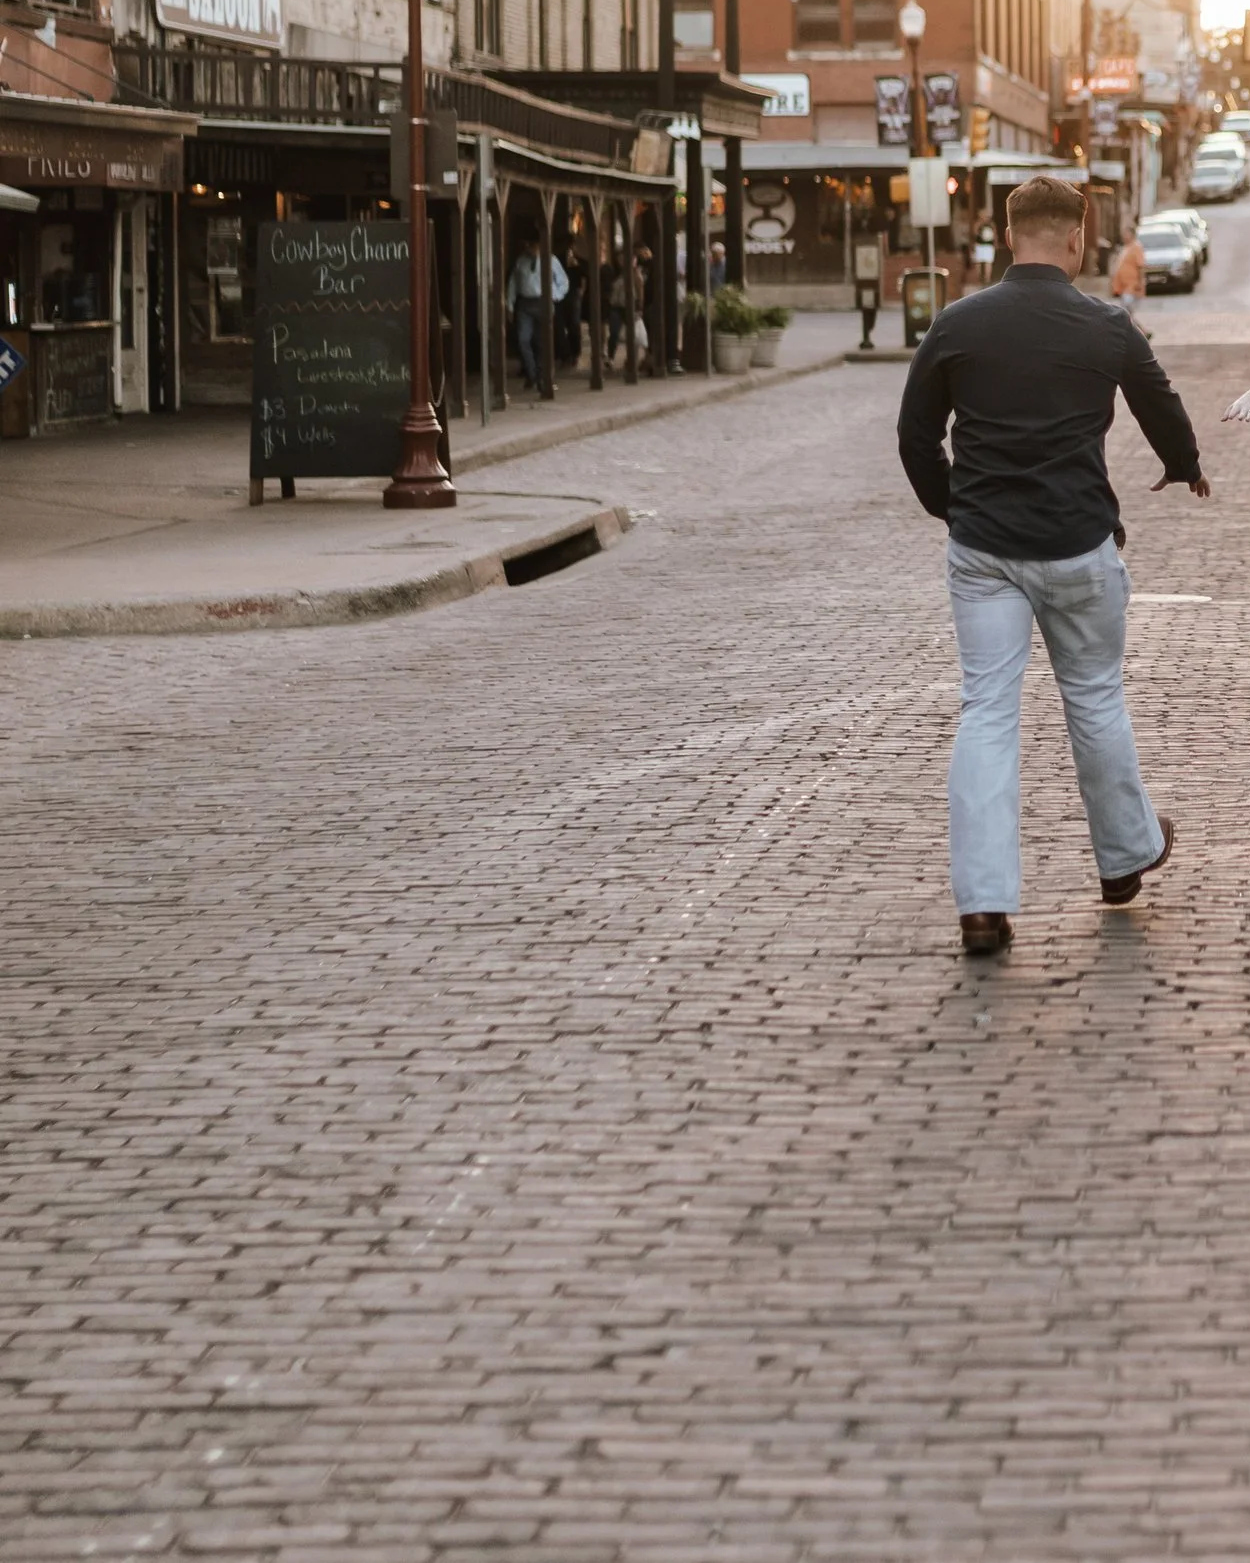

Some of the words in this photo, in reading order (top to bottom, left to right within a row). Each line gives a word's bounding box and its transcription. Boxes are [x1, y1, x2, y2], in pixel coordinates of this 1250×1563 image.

[763, 93, 806, 116] ORE
[271, 227, 348, 271] Cowboy
[350, 225, 410, 262] Chann
[313, 264, 366, 295] Bar
